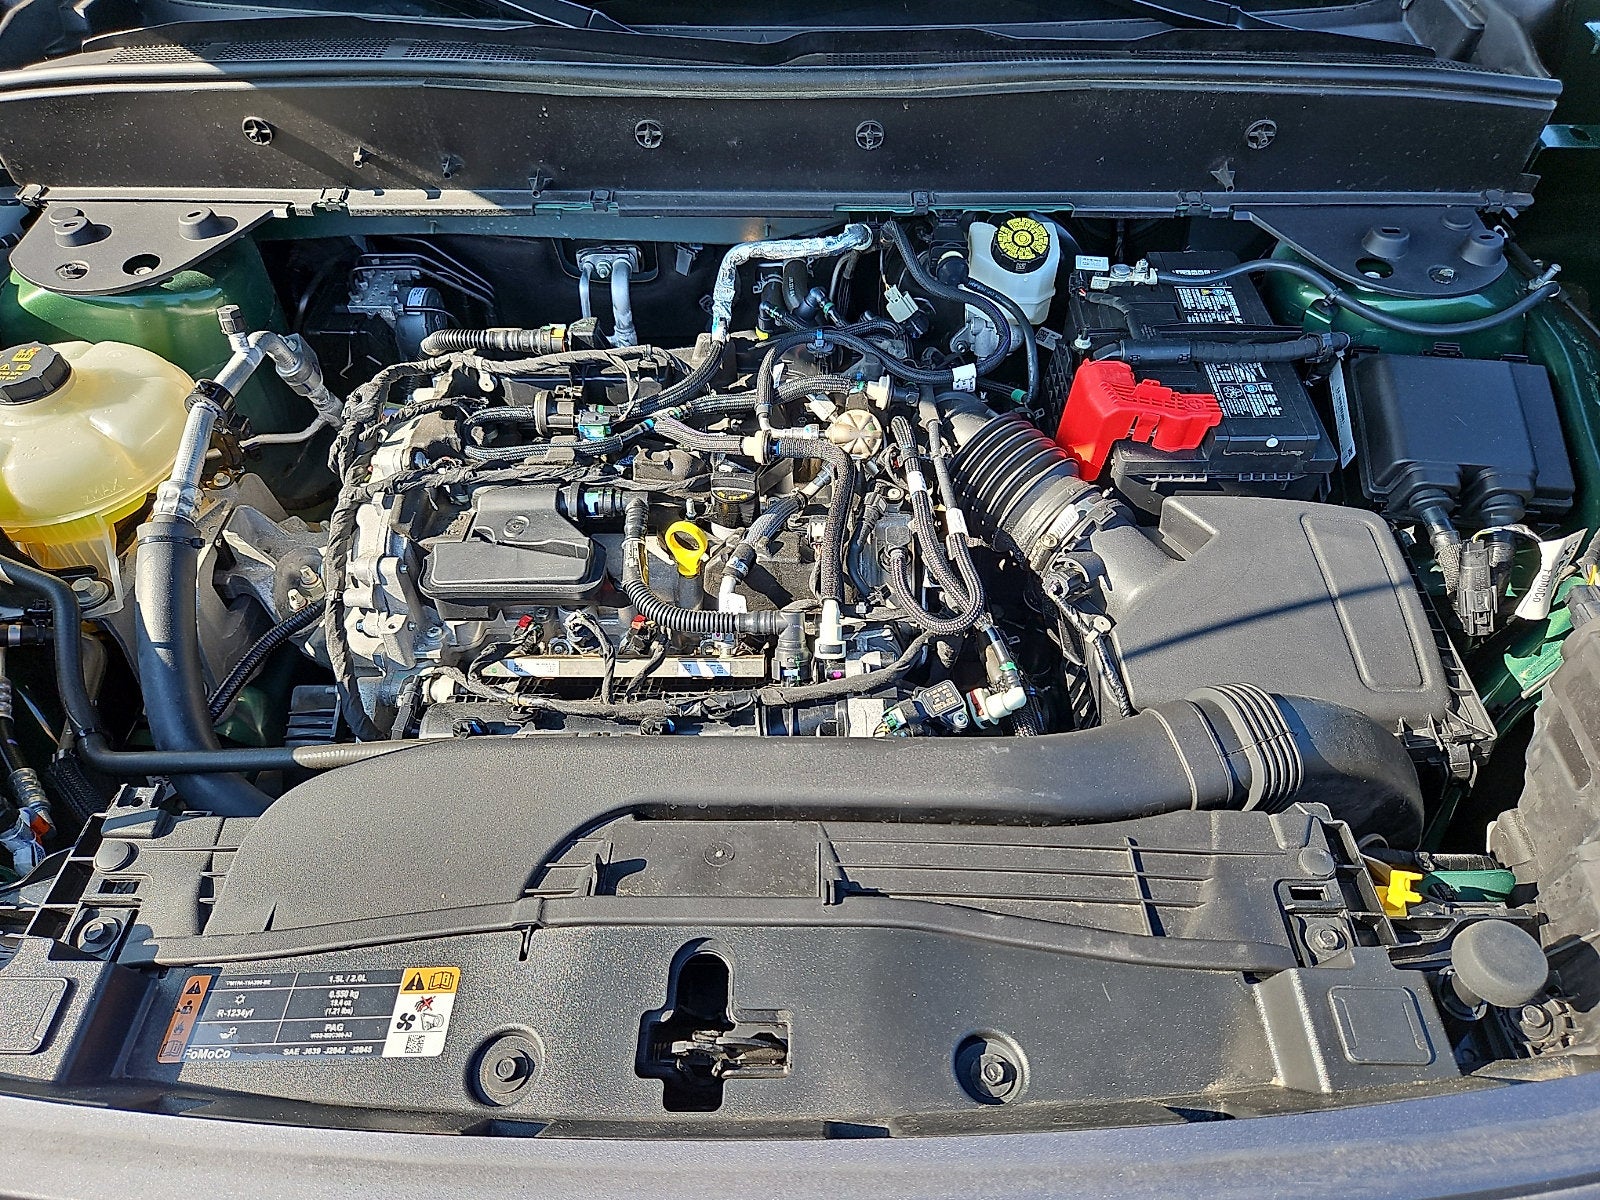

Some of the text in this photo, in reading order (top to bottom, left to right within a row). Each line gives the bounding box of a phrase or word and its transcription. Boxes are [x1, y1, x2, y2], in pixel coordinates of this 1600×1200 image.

[328, 974, 344, 984] 1.5L
[350, 973, 367, 983] 2.0L
[349, 989, 359, 999] kg
[217, 1008, 254, 1019] R-1234yf
[324, 1023, 344, 1032] PAG
[183, 1048, 231, 1060] FoMoCo
[282, 1047, 300, 1056] SAE
